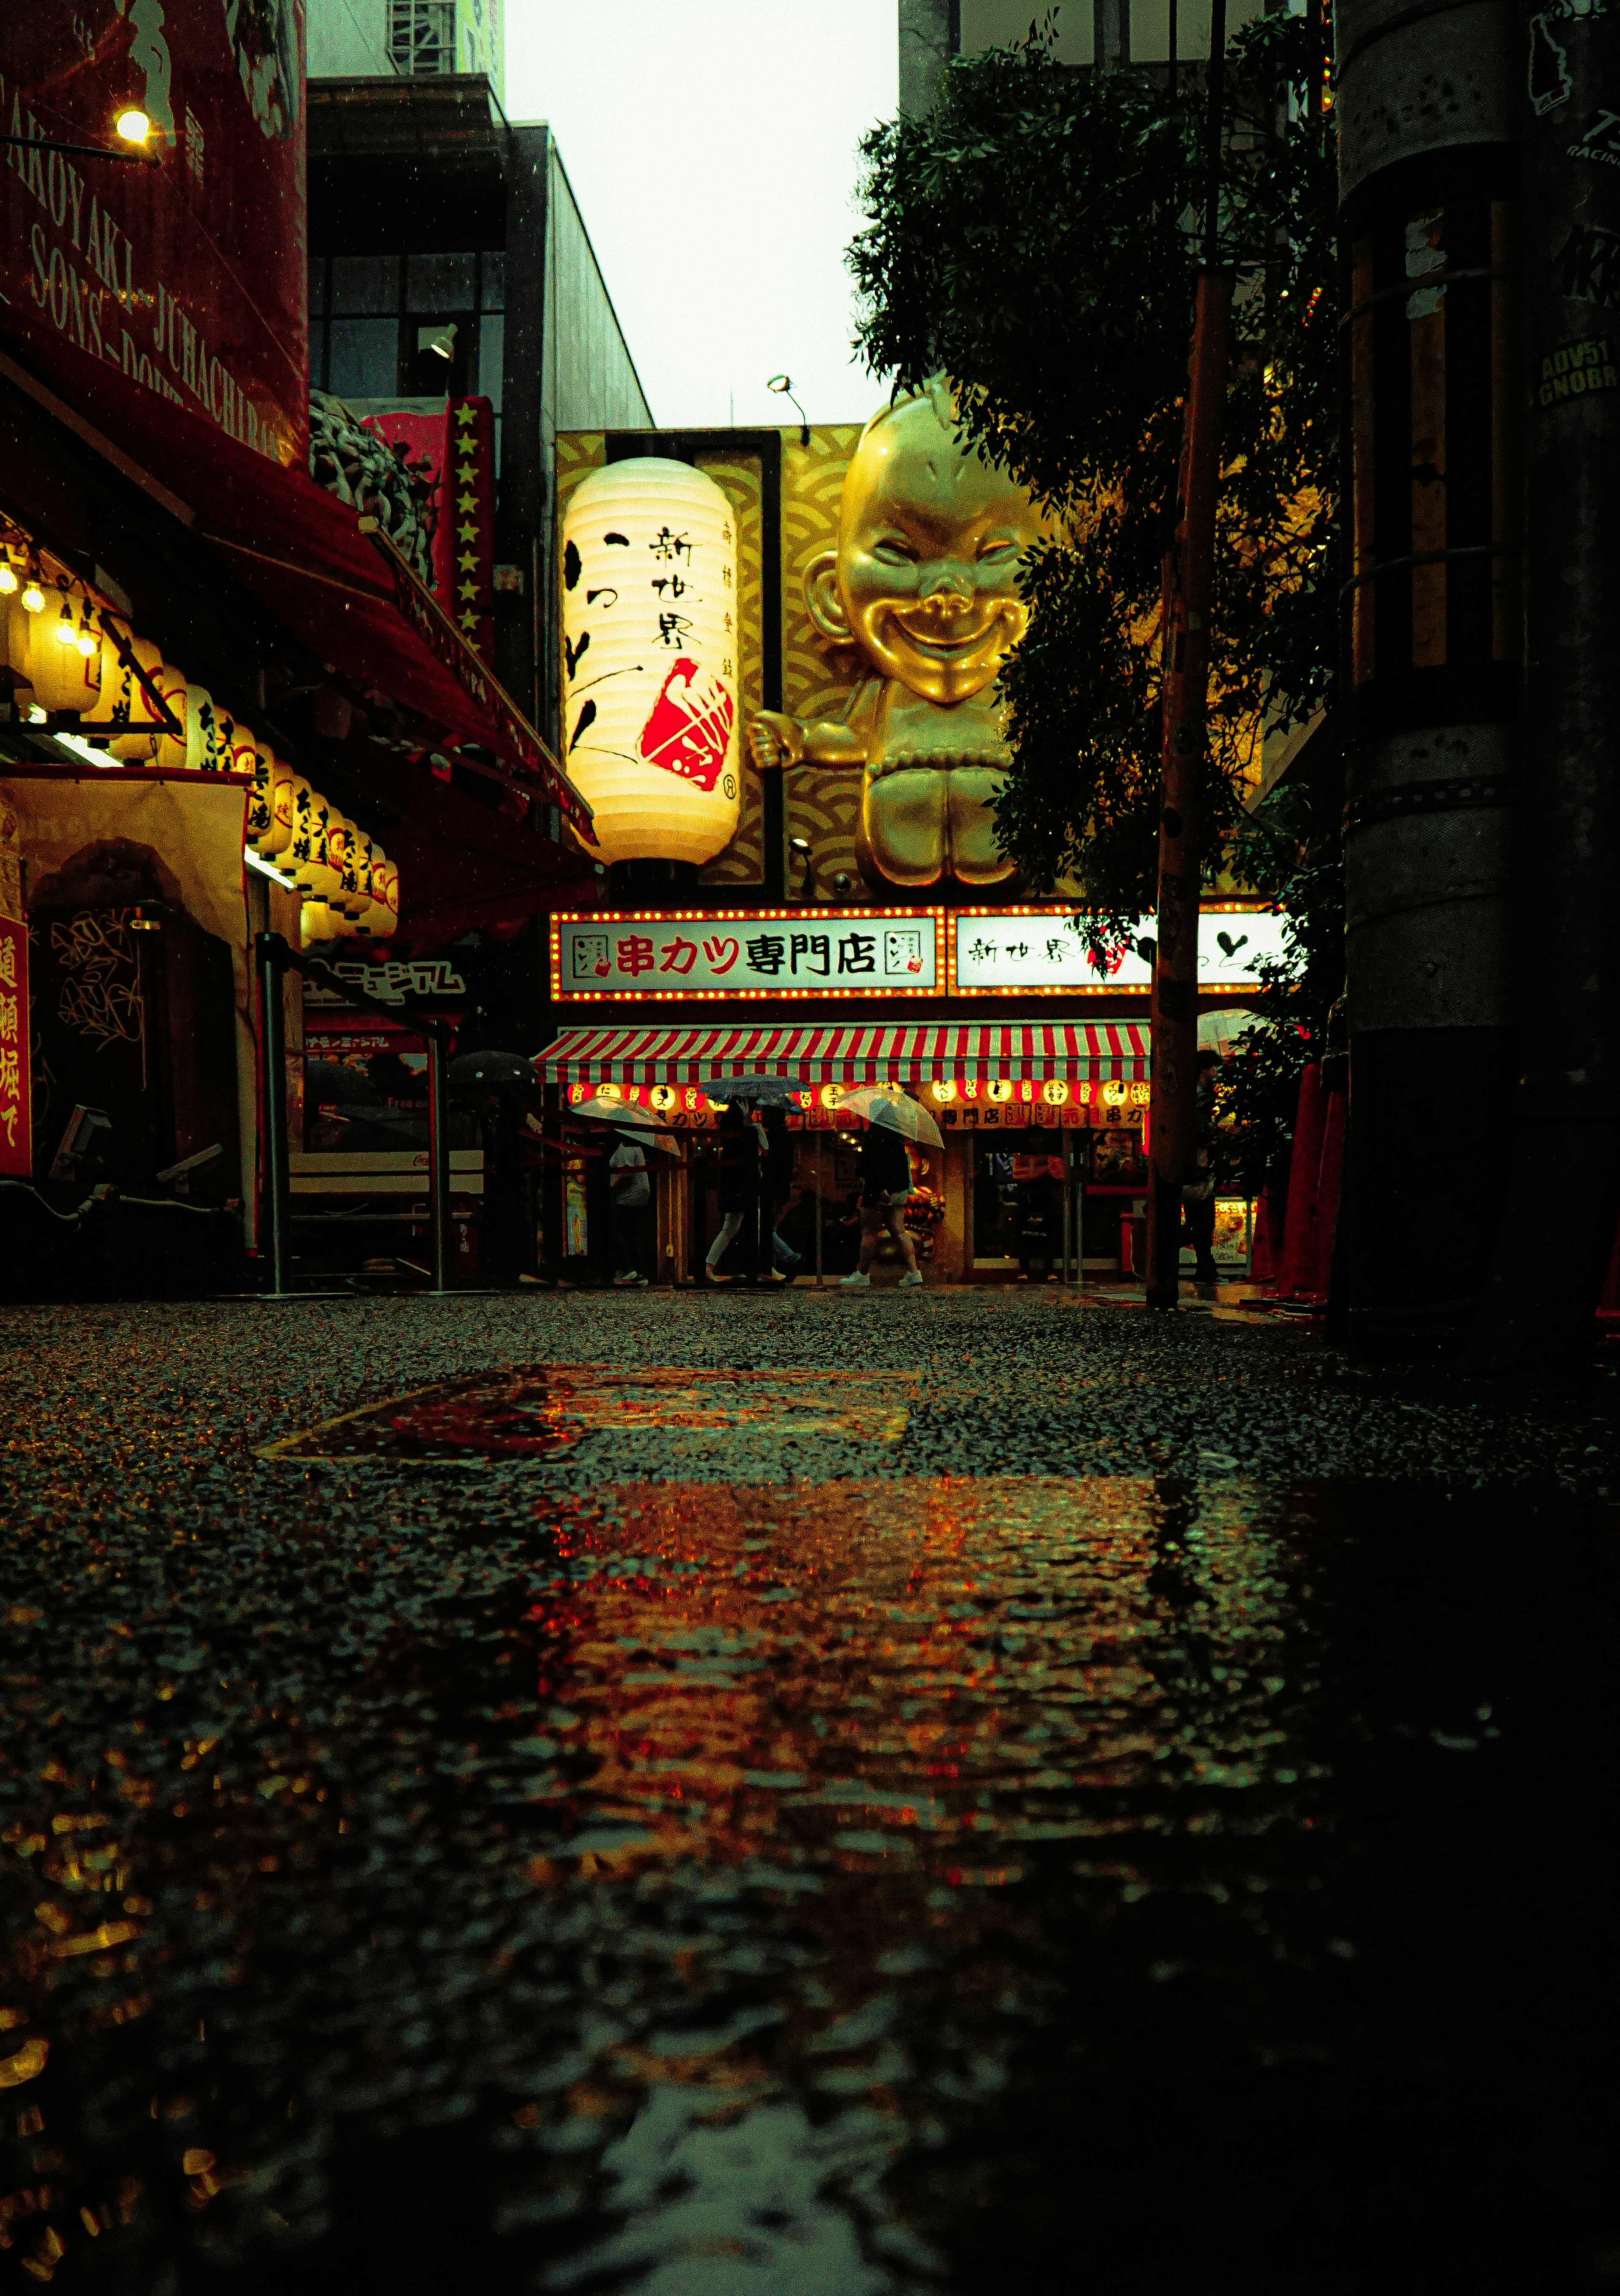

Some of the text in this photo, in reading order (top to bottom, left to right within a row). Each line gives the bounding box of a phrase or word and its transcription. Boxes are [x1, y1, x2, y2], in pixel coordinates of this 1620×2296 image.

[648, 526, 702, 649] 新世界
[617, 933, 876, 978] 串カツ専門店
[969, 938, 1075, 965] 新世界
[829, 1086, 839, 1106] 玉子
